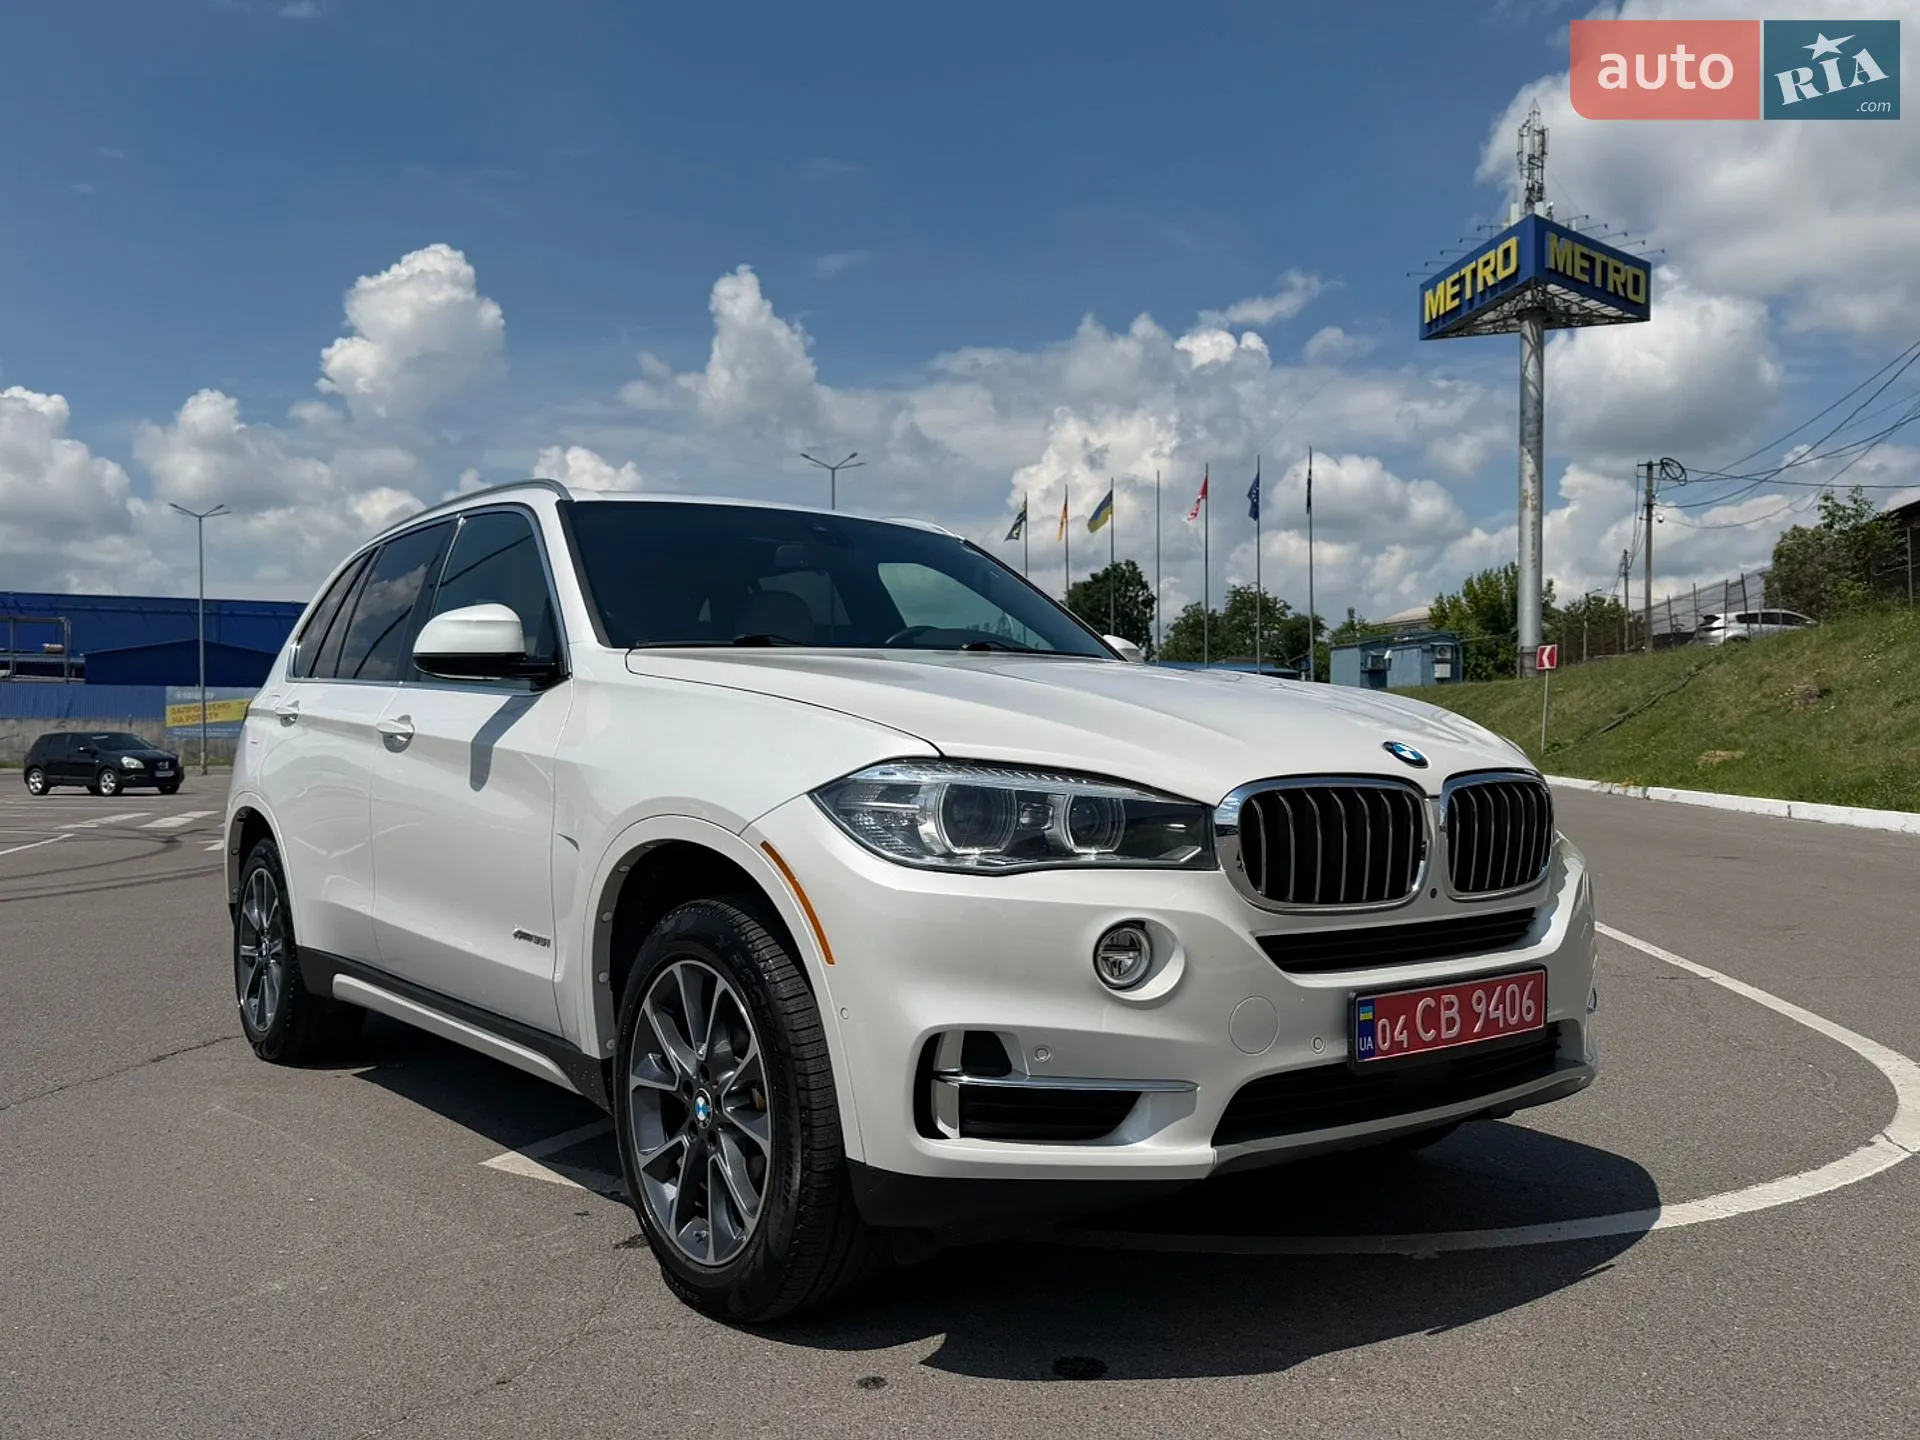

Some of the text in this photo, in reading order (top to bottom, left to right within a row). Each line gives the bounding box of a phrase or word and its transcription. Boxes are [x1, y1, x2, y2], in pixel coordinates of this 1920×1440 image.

[1424, 236, 1519, 324] METRO
[1545, 231, 1647, 304] METRO
[1359, 1036, 1374, 1051] UA
[1377, 980, 1535, 1051] 04 CB 9406
